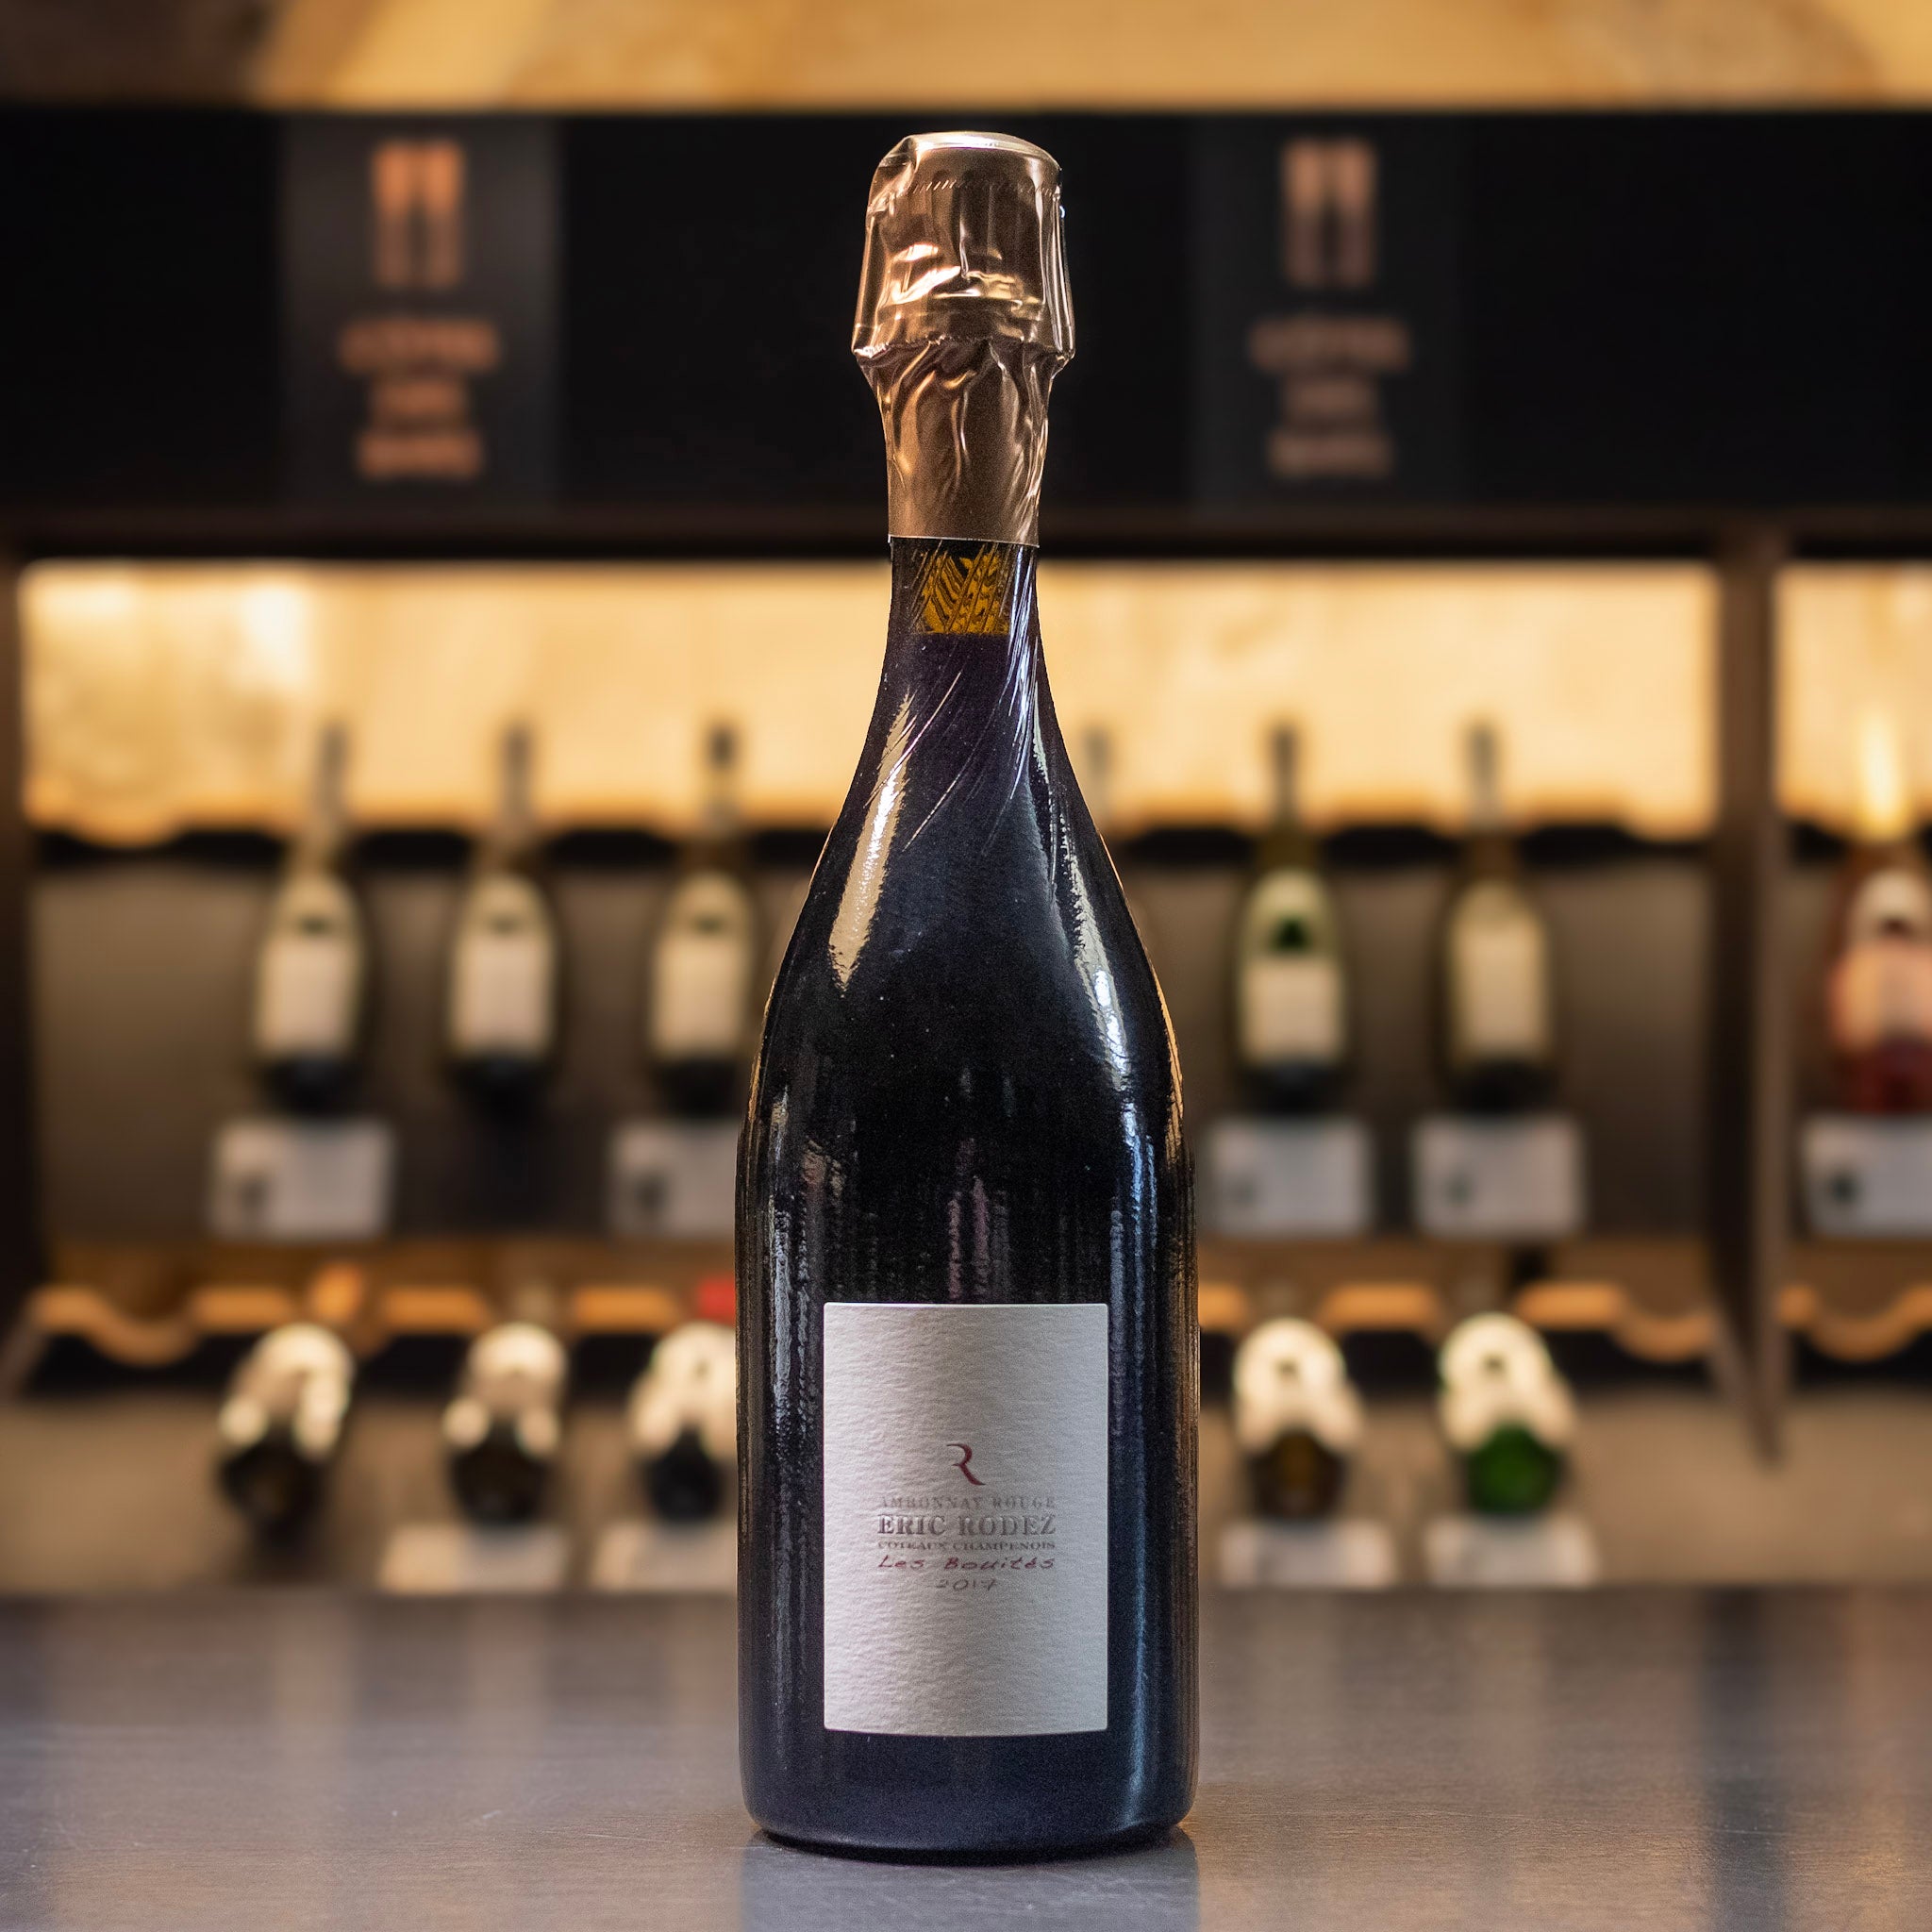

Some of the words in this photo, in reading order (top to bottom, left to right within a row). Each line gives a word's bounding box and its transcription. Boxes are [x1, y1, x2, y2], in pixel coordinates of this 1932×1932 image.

[946, 1442, 986, 1486] R
[881, 1496, 982, 1508] AMBONNAY
[992, 1496, 1056, 1508] ROUGE
[877, 1513, 945, 1535] ERIC
[958, 1513, 1056, 1536] RODEZ
[878, 1541, 947, 1550] COTEAUX
[953, 1541, 1056, 1551] CHAMPENOIS
[878, 1555, 925, 1571] Les
[937, 1578, 996, 1591] 2017
